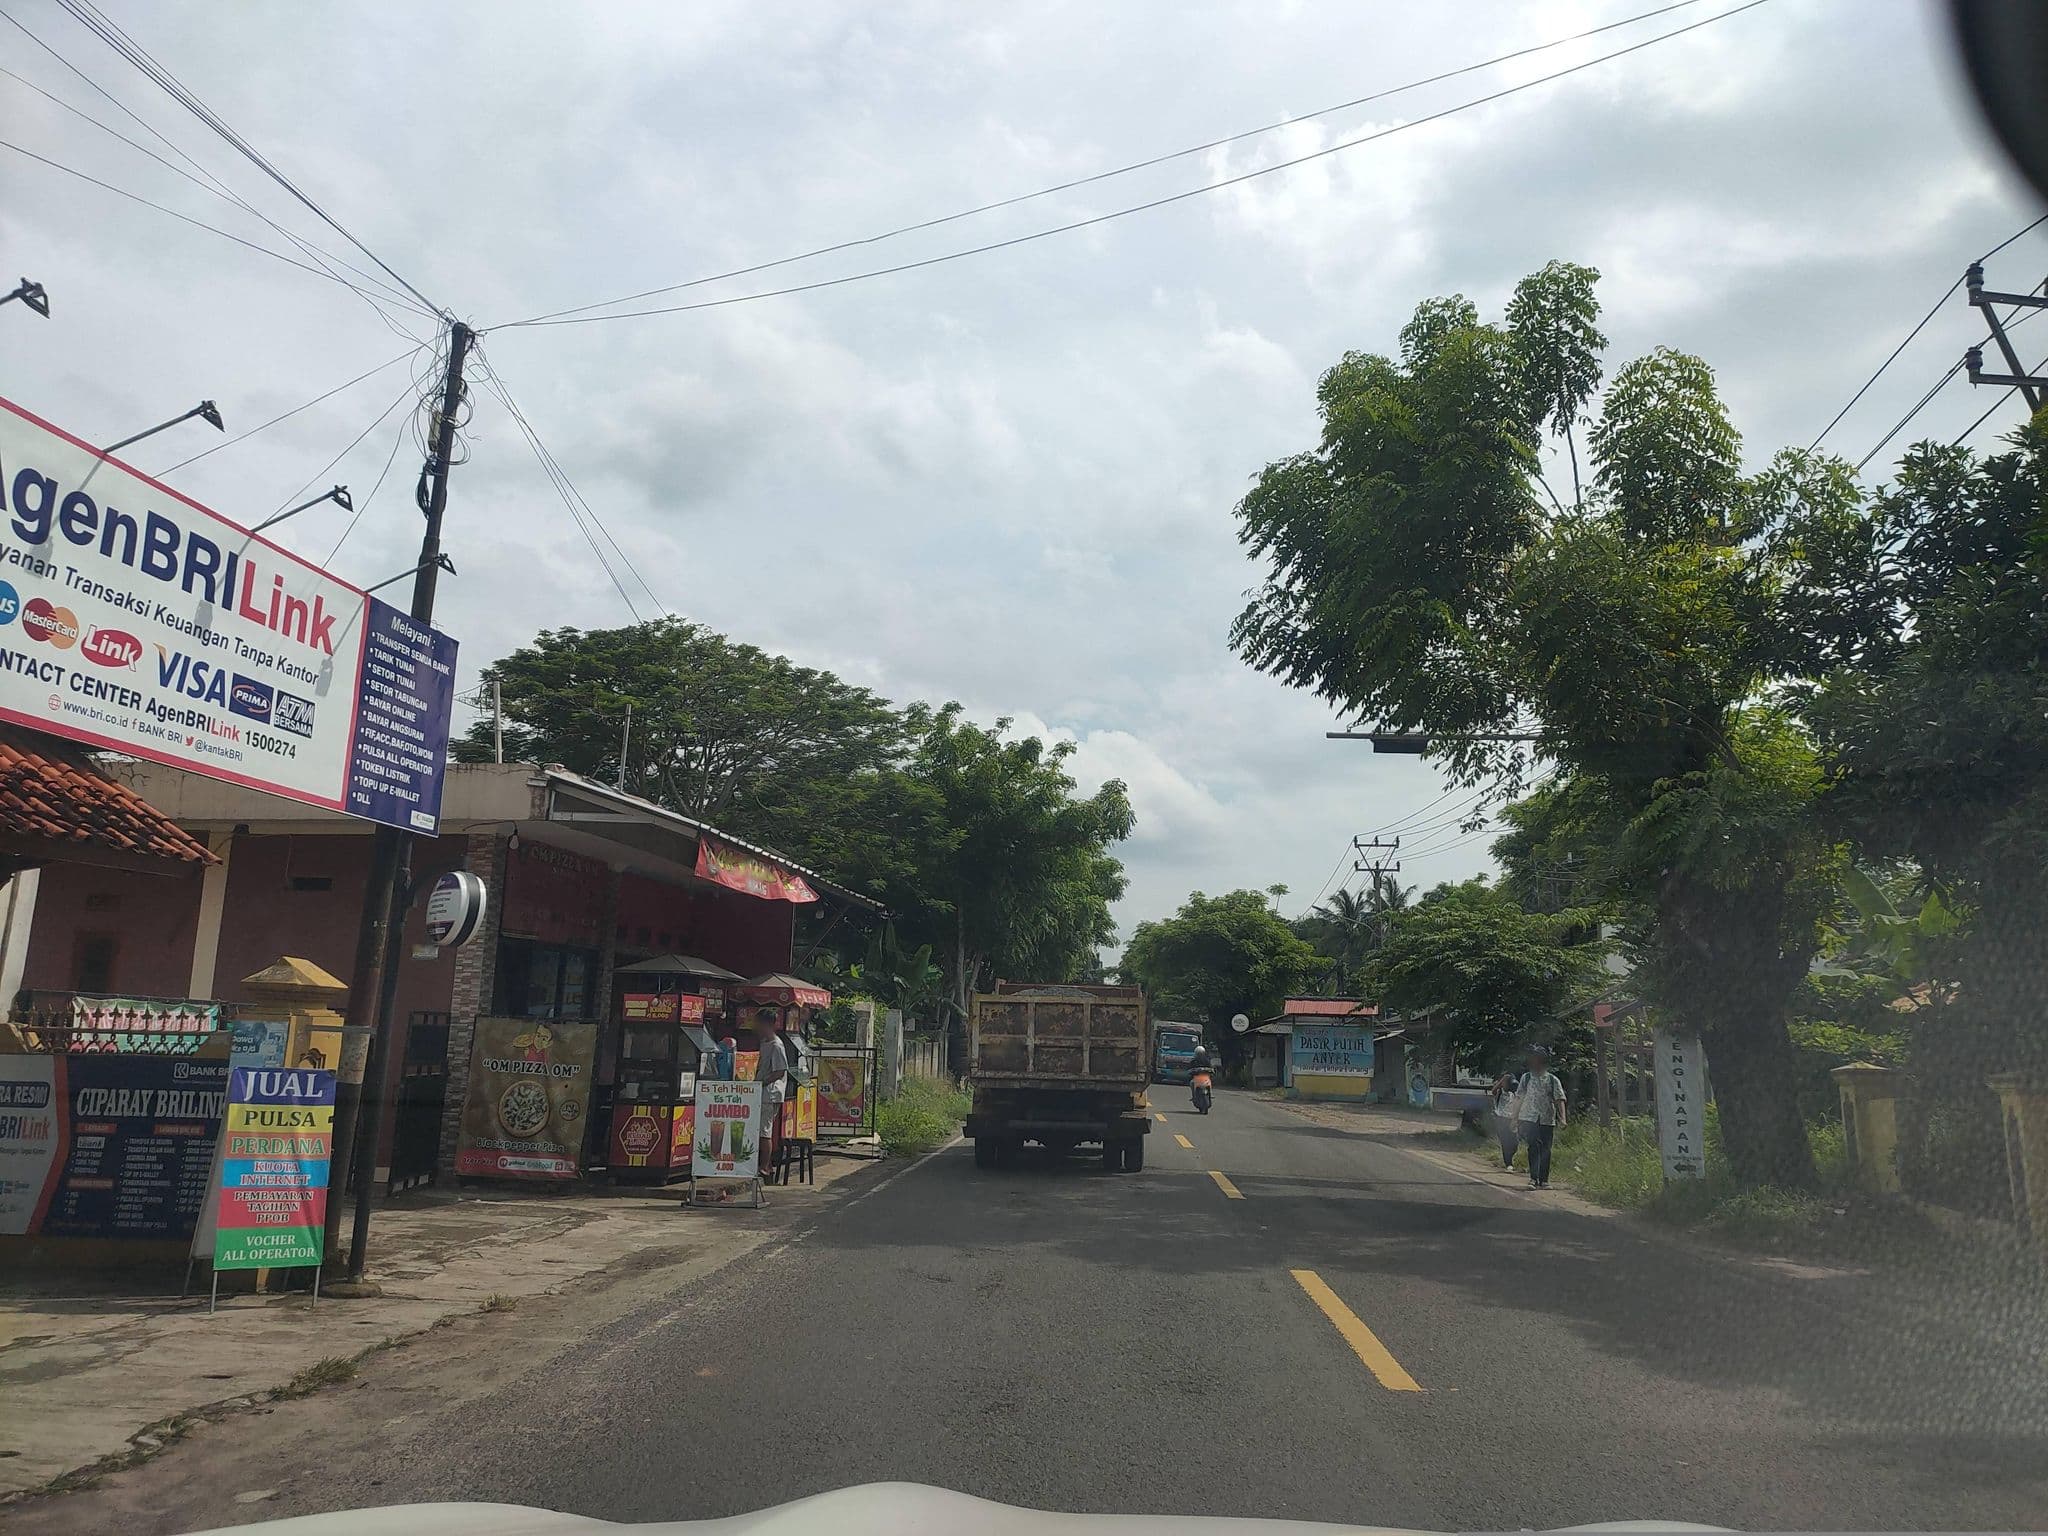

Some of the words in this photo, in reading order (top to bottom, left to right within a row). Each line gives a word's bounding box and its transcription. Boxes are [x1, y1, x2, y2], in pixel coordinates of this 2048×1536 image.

[0, 452, 336, 656] genBRILink
[23, 609, 77, 639] MasterCard
[65, 566, 152, 618] Transaksi
[154, 604, 229, 650] Keuangan
[235, 637, 274, 668] Tanpa
[277, 655, 320, 685] Kantor
[390, 616, 431, 646] Melayani
[84, 624, 138, 672] Link
[376, 632, 411, 656] TRANSFER
[411, 649, 432, 667] SEMUA
[433, 660, 450, 675] BANK
[373, 647, 394, 665] TARIK
[396, 658, 415, 674] TUNAI
[153, 642, 226, 708] VISA
[372, 663, 395, 681] SETOR
[396, 673, 416, 690] TUNAI
[235, 689, 268, 710] PRIMA
[370, 680, 393, 697] SETOR
[394, 690, 428, 712] TABUNGAN
[70, 672, 142, 711] CENTER
[146, 697, 240, 742] AgenBRILink
[245, 730, 297, 759] 1500274
[277, 694, 315, 724] ATM
[369, 695, 392, 713] BAYAR
[392, 705, 416, 722] ONLINE
[64, 701, 128, 728] www.bri.co.id
[139, 722, 166, 738] BANK
[167, 730, 182, 744] BRI
[274, 716, 313, 737] BERSAMA
[366, 711, 389, 728] BAYAR
[390, 720, 425, 741] ANGSURAN
[362, 743, 385, 759] PULSA
[386, 752, 399, 764] ALL
[400, 756, 433, 776] OPERATOR
[361, 759, 385, 776] TOKEN
[386, 767, 411, 784] LISTRIK
[357, 792, 371, 805] DLL
[389, 785, 420, 803] E-WALLET
[1301, 1037, 1334, 1051] PASIR
[1333, 1038, 1368, 1053] PUTIH
[1312, 1051, 1351, 1064] ANYER
[189, 1066, 216, 1077] BANK
[511, 1061, 550, 1076] PIZZA
[13, 1086, 48, 1104] RESMI
[243, 1071, 323, 1101] JUAL
[701, 1084, 710, 1093] Es
[712, 1084, 728, 1093] Teh
[730, 1084, 754, 1095] Hijau
[76, 1087, 154, 1117] CIPARAY
[714, 1094, 724, 1103] Es
[725, 1094, 742, 1103] Teh
[243, 1110, 316, 1127] PULSA
[704, 1103, 751, 1119] JUMBO
[230, 1136, 325, 1155] PERDANA
[254, 1161, 300, 1172] KUOTA
[240, 1174, 311, 1186] INTERNET
[233, 1190, 314, 1201] PEMBAYARAN
[247, 1202, 300, 1212] TAGIHAN
[255, 1212, 290, 1223] PPOB
[246, 1235, 295, 1246] VOCHER
[222, 1250, 246, 1261] ALL
[249, 1247, 315, 1259] OPERATOR
